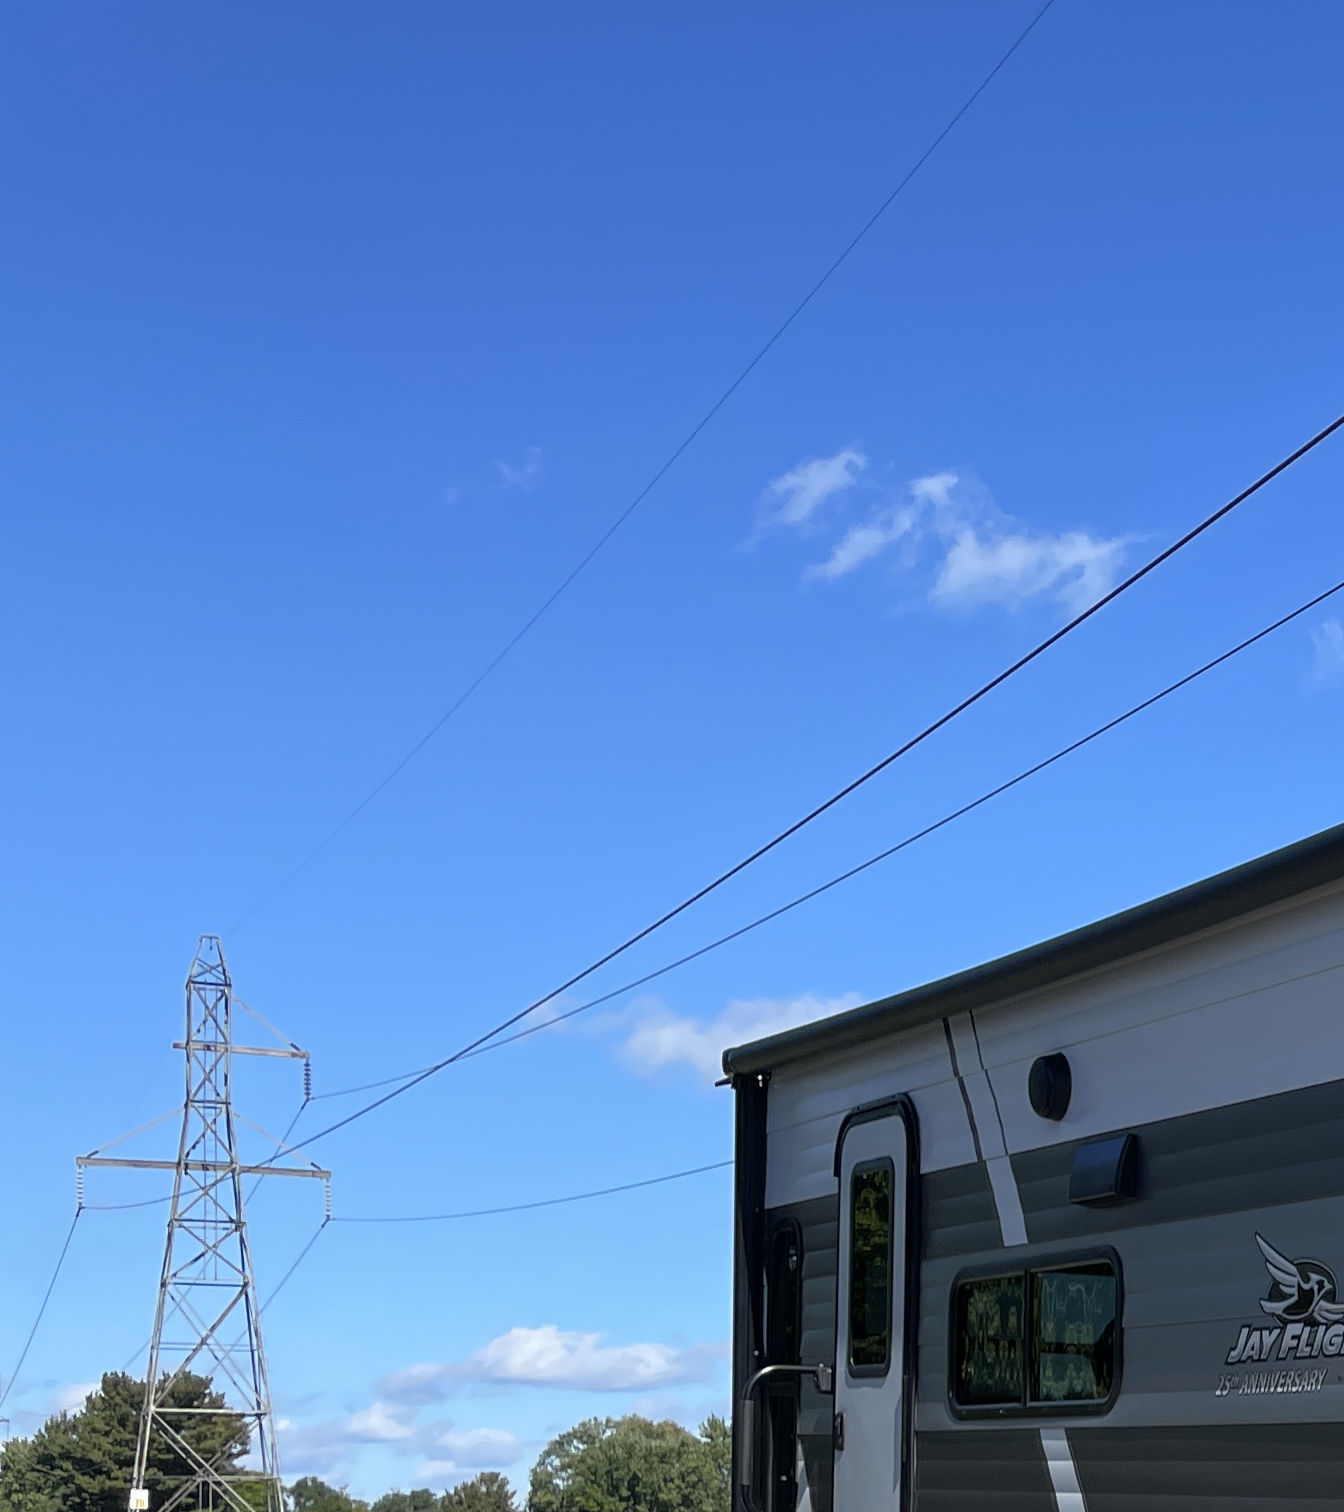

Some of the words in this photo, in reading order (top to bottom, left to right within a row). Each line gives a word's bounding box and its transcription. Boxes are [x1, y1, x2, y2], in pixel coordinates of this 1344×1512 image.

[1224, 1323, 1281, 1366] JAY
[1214, 1371, 1240, 1396] 25th
[1238, 1367, 1328, 1396] ANNIVERSARY
